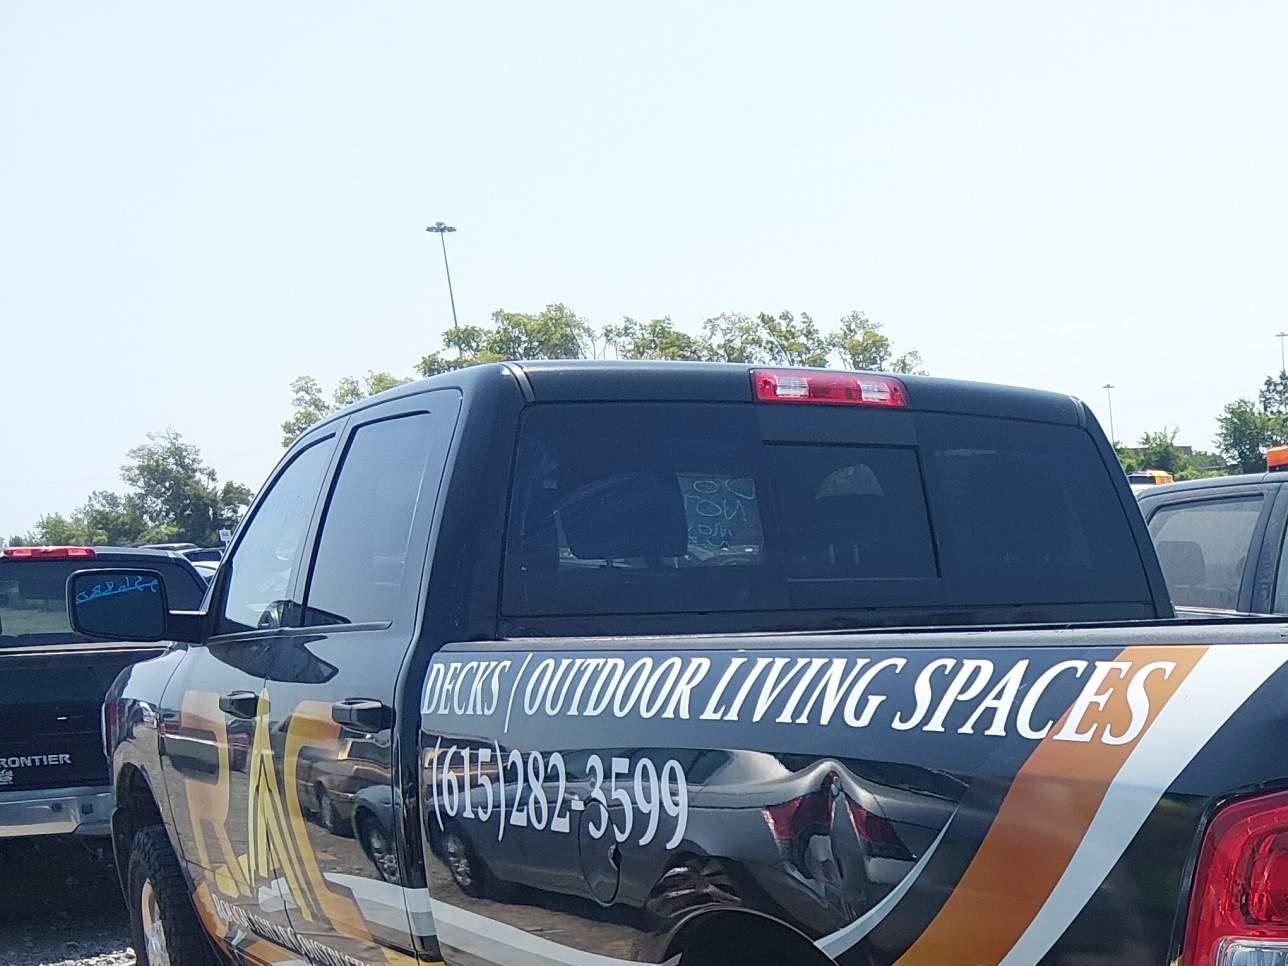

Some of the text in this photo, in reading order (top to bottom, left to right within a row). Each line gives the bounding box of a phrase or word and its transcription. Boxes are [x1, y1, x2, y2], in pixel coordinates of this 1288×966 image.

[421, 660, 512, 716] DECKS
[523, 657, 711, 720] OUTDOOR
[699, 657, 907, 728] LIVING
[890, 659, 1177, 746] SPACES
[432, 736, 689, 850] (615)282-3599
